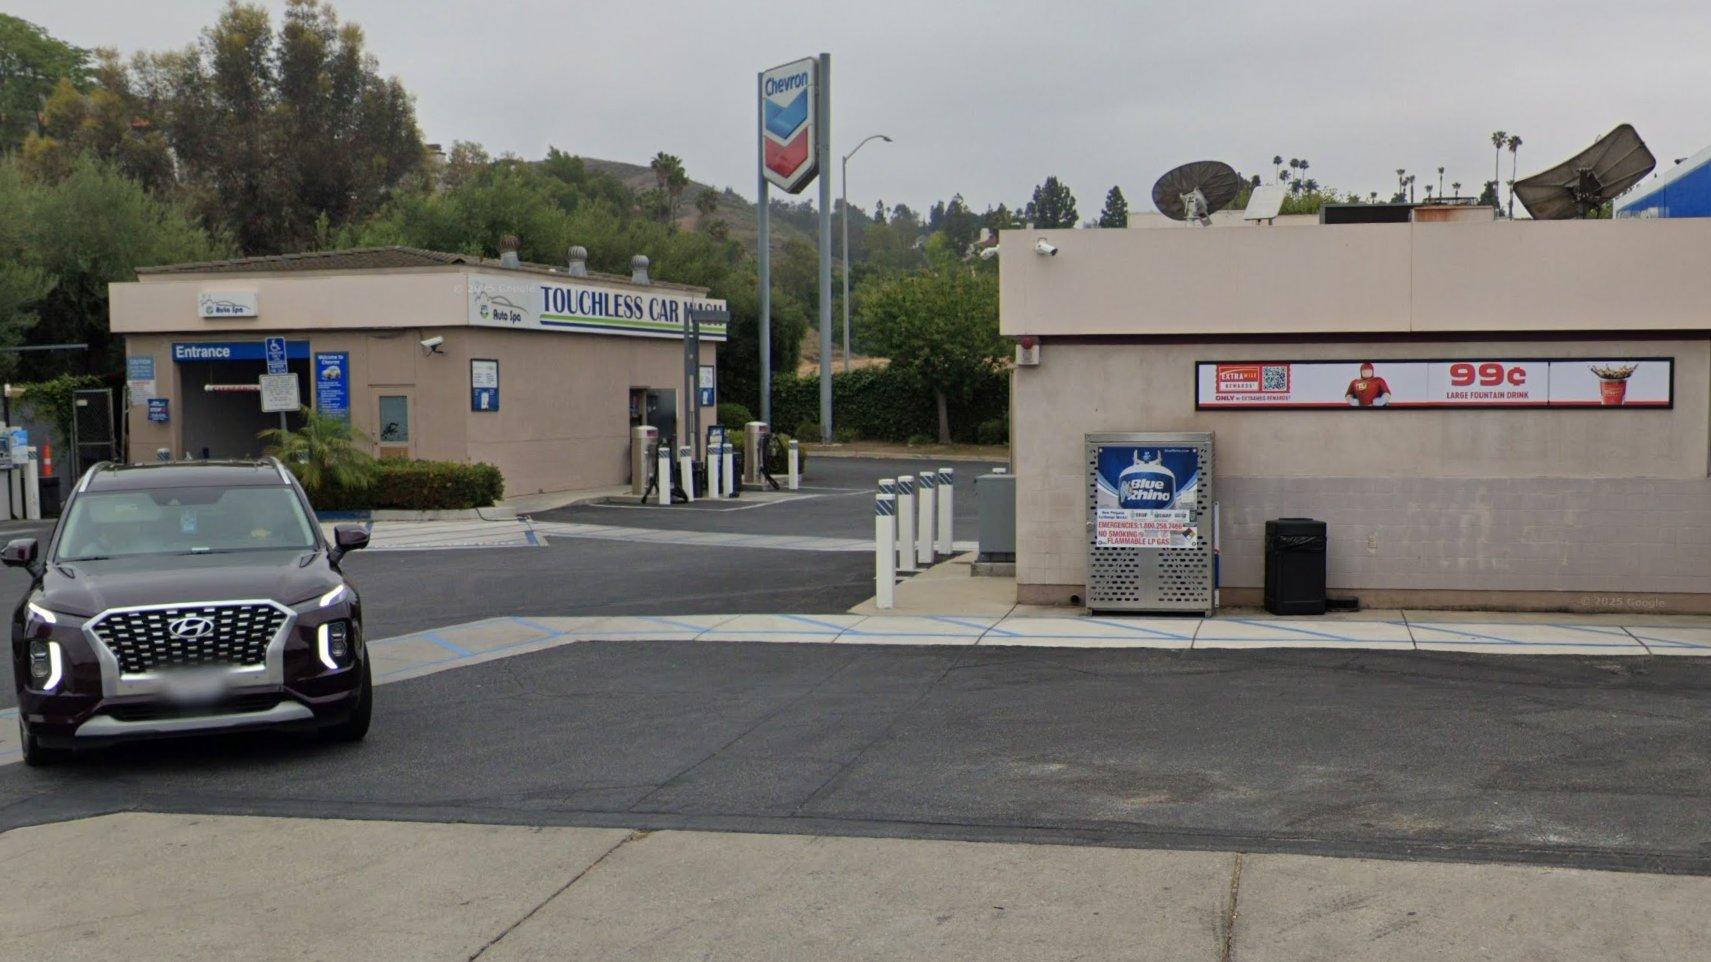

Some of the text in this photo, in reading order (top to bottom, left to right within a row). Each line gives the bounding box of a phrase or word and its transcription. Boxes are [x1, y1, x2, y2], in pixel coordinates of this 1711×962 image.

[765, 72, 808, 96] Chevron
[232, 306, 243, 314] Spa
[540, 286, 644, 321] TOUCHLESS
[649, 297, 679, 323] CAR
[493, 309, 522, 324] Auto Spa
[176, 345, 231, 359] Entrance
[1446, 391, 1529, 399] LARGE FOUNTAIN DRINK
[1131, 478, 1165, 490] Blue
[1107, 537, 1146, 545] FLAMMABLE
